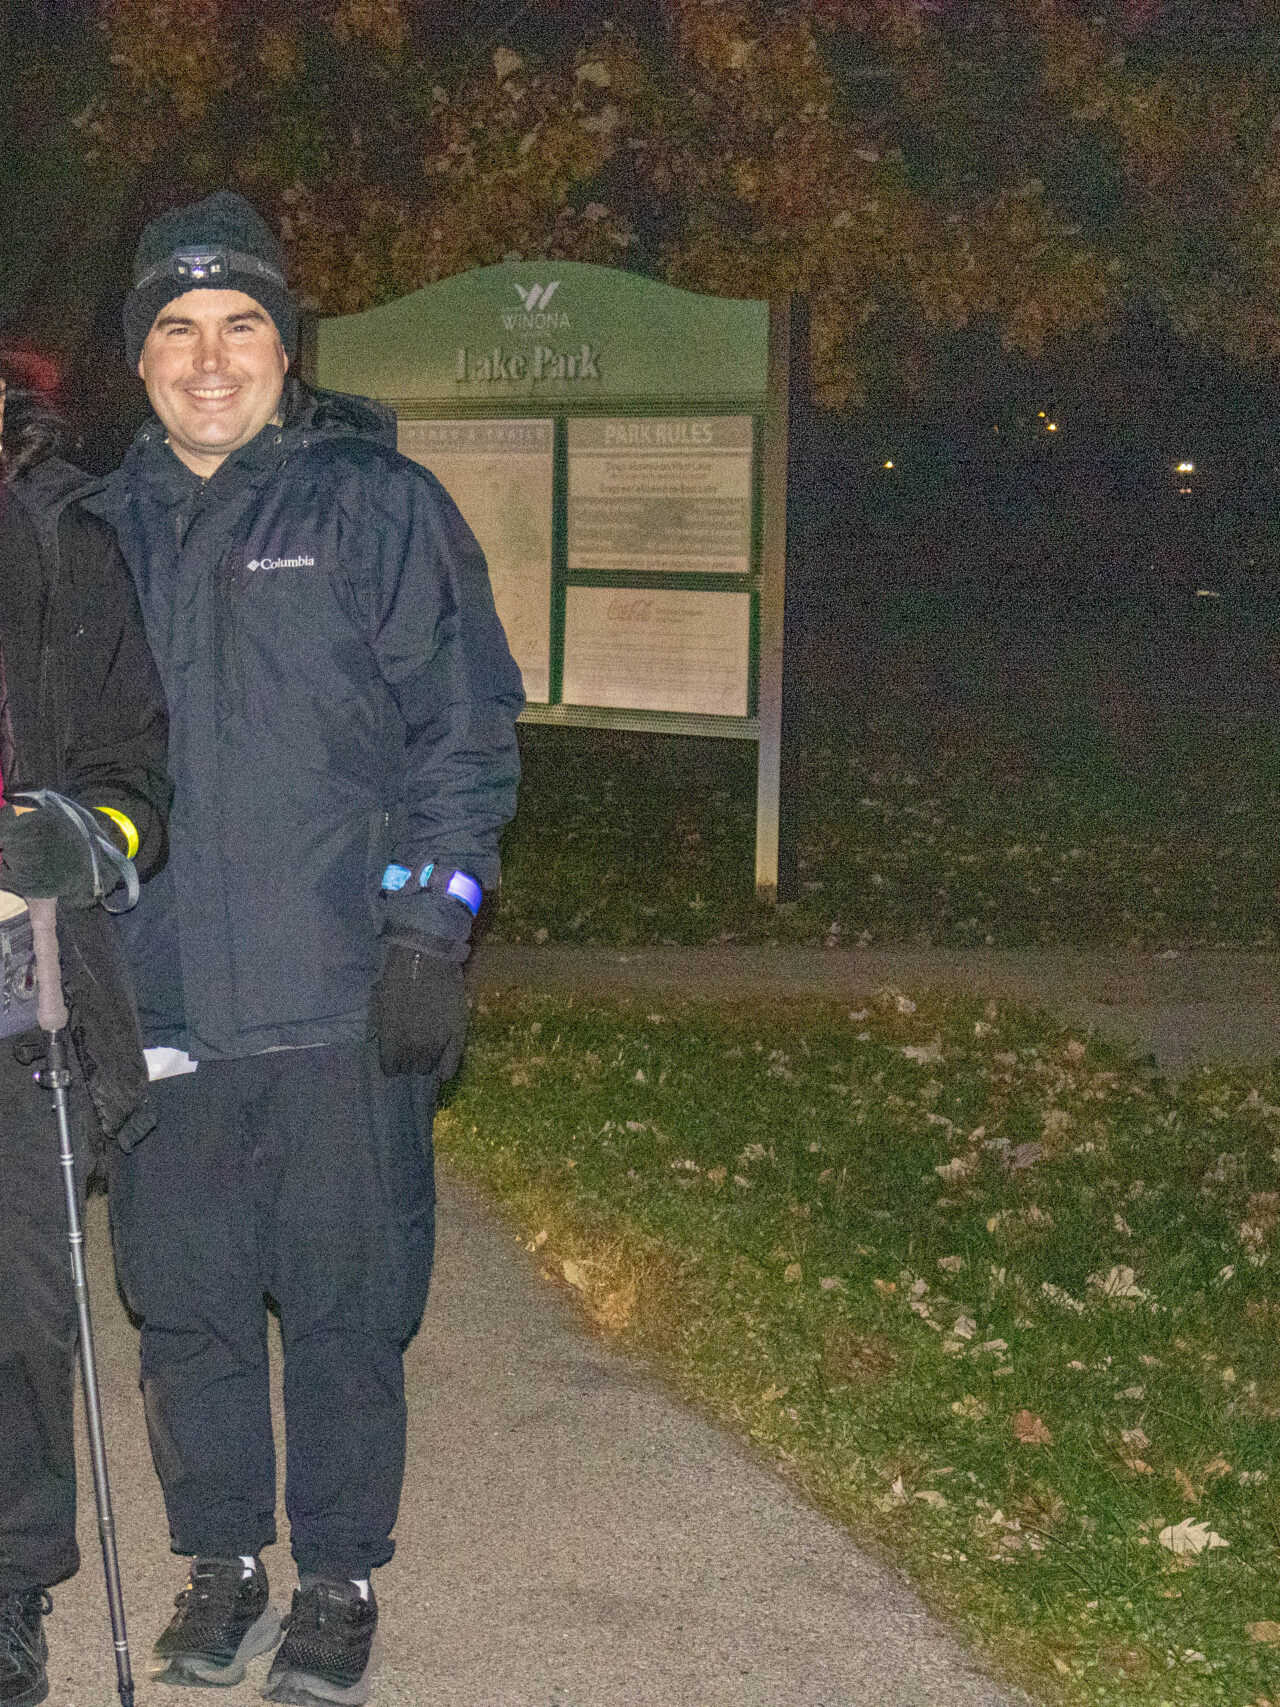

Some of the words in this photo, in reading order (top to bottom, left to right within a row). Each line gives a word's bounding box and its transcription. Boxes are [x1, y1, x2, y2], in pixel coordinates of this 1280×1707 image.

[501, 313, 571, 331] WINONA
[457, 346, 527, 383] Lake
[533, 343, 601, 381] Park
[605, 423, 652, 444] PARK
[655, 422, 713, 444] RULES
[260, 555, 315, 570] Columbia
